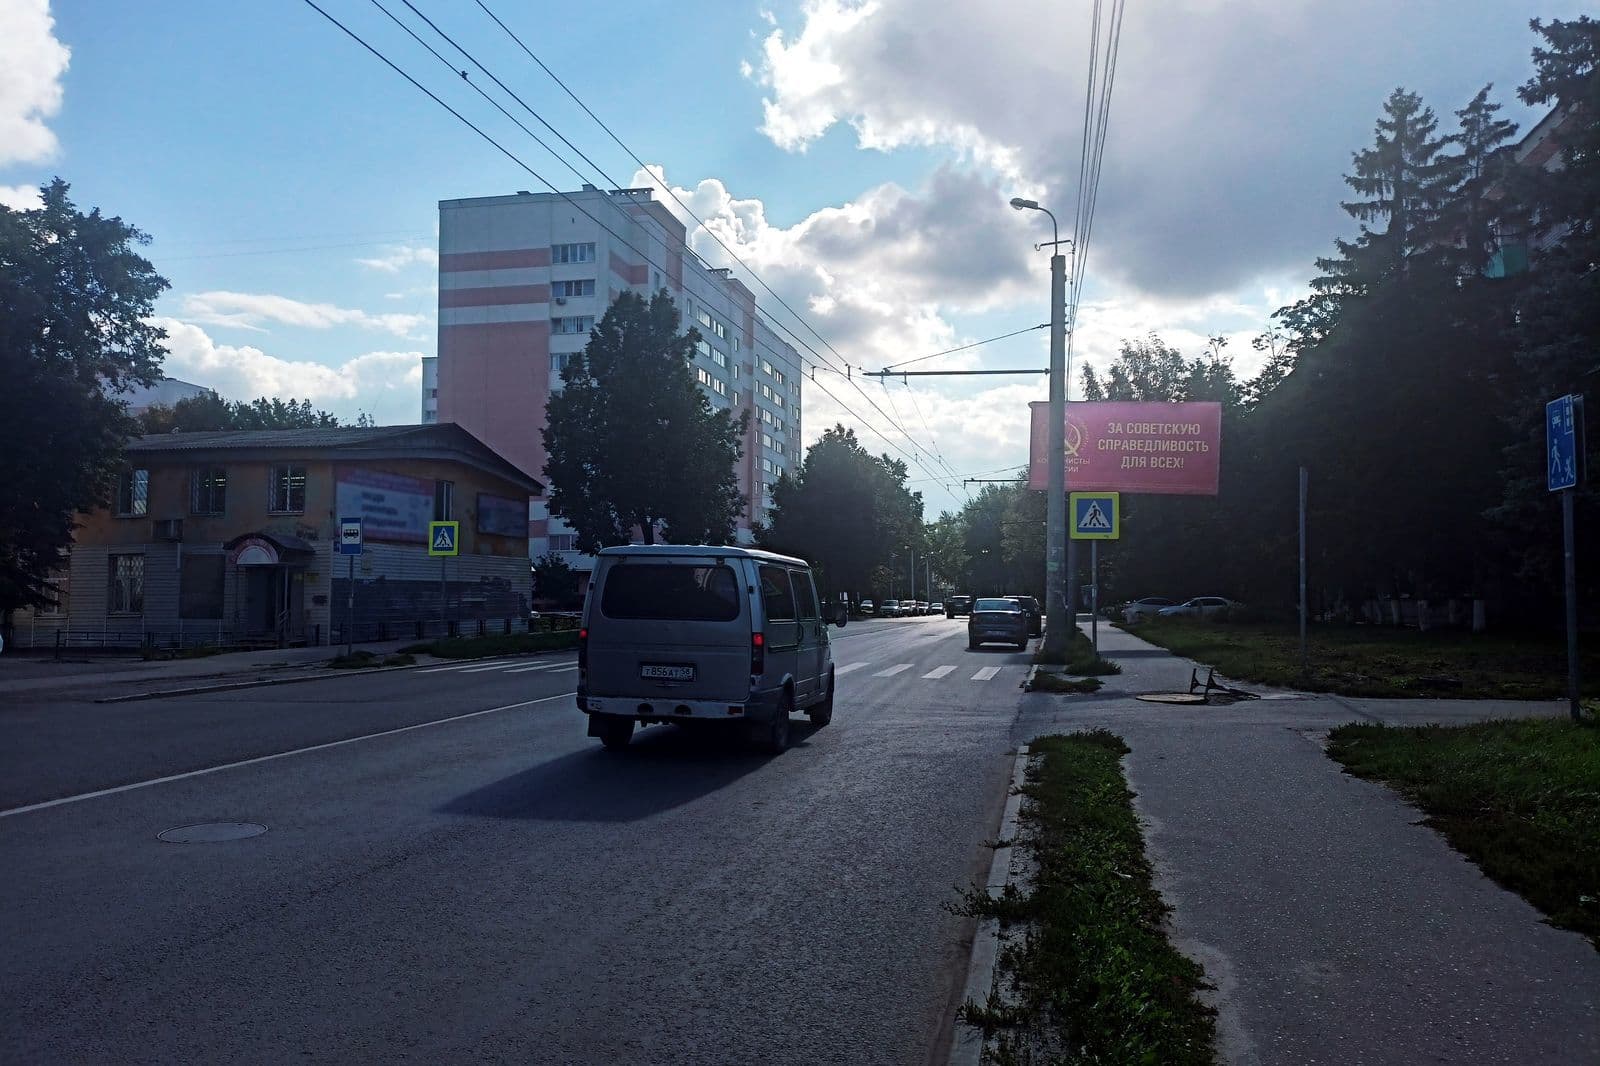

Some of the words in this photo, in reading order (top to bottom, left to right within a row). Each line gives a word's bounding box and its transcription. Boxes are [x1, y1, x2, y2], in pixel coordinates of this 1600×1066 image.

[1107, 422, 1123, 434] ЗА
[1126, 422, 1201, 435] СОВЕТСКУЮ
[1098, 439, 1209, 452] СПРАВЕДЛИВОСТЬ
[1120, 456, 1147, 469] ДЛЯ
[1150, 456, 1184, 469] ВСЕХ!
